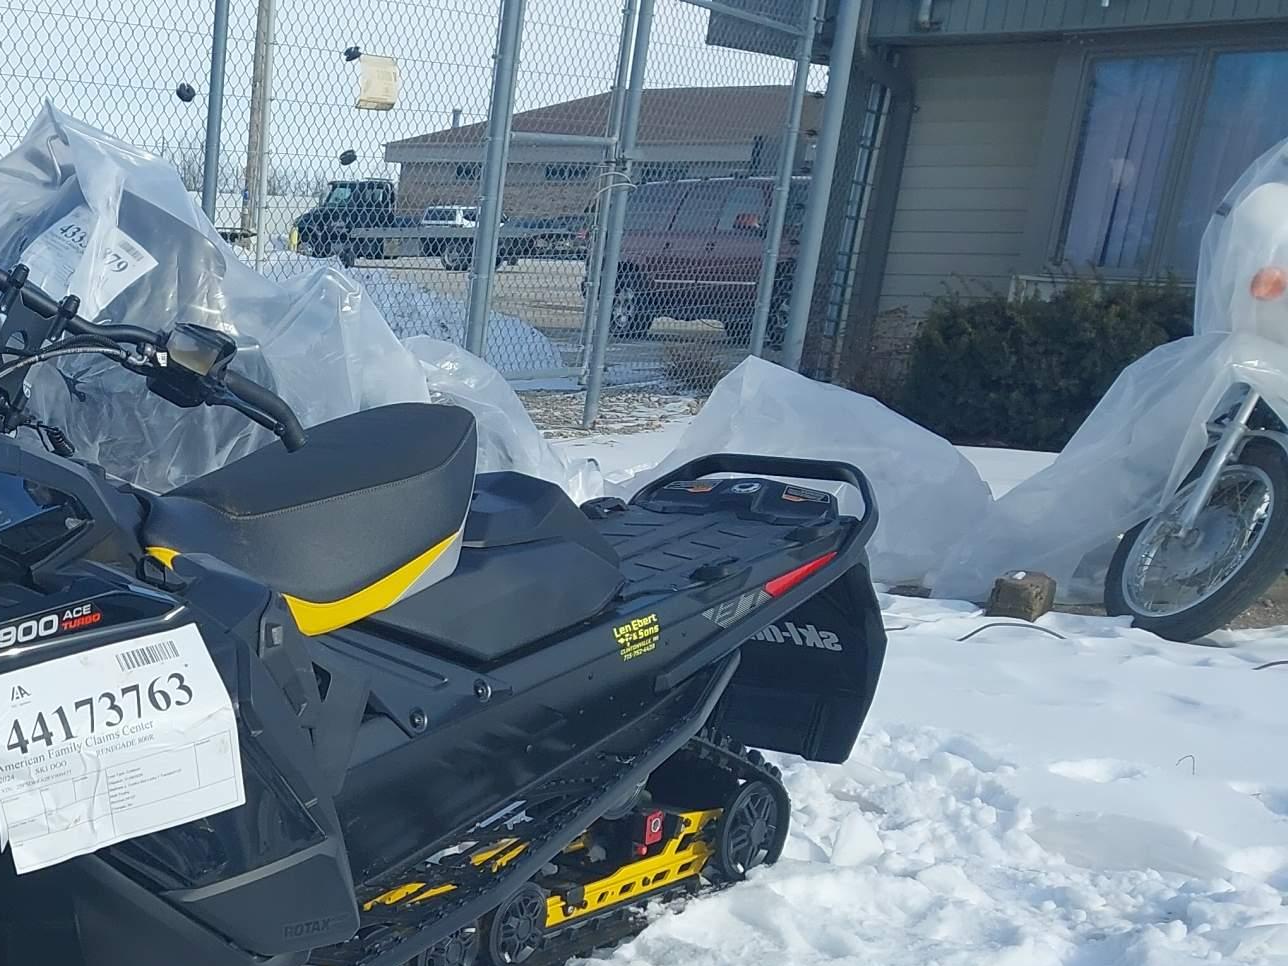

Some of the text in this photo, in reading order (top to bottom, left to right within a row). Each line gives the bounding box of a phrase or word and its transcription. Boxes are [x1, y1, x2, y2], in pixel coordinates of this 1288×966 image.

[62, 612, 102, 630] TURBO
[63, 604, 92, 620] ACE
[613, 613, 658, 639] Len Ebert
[638, 624, 660, 639] Sons
[7, 672, 193, 754] 44173763
[48, 741, 83, 759] Family
[85, 730, 120, 748] Claims
[122, 720, 154, 736] Center
